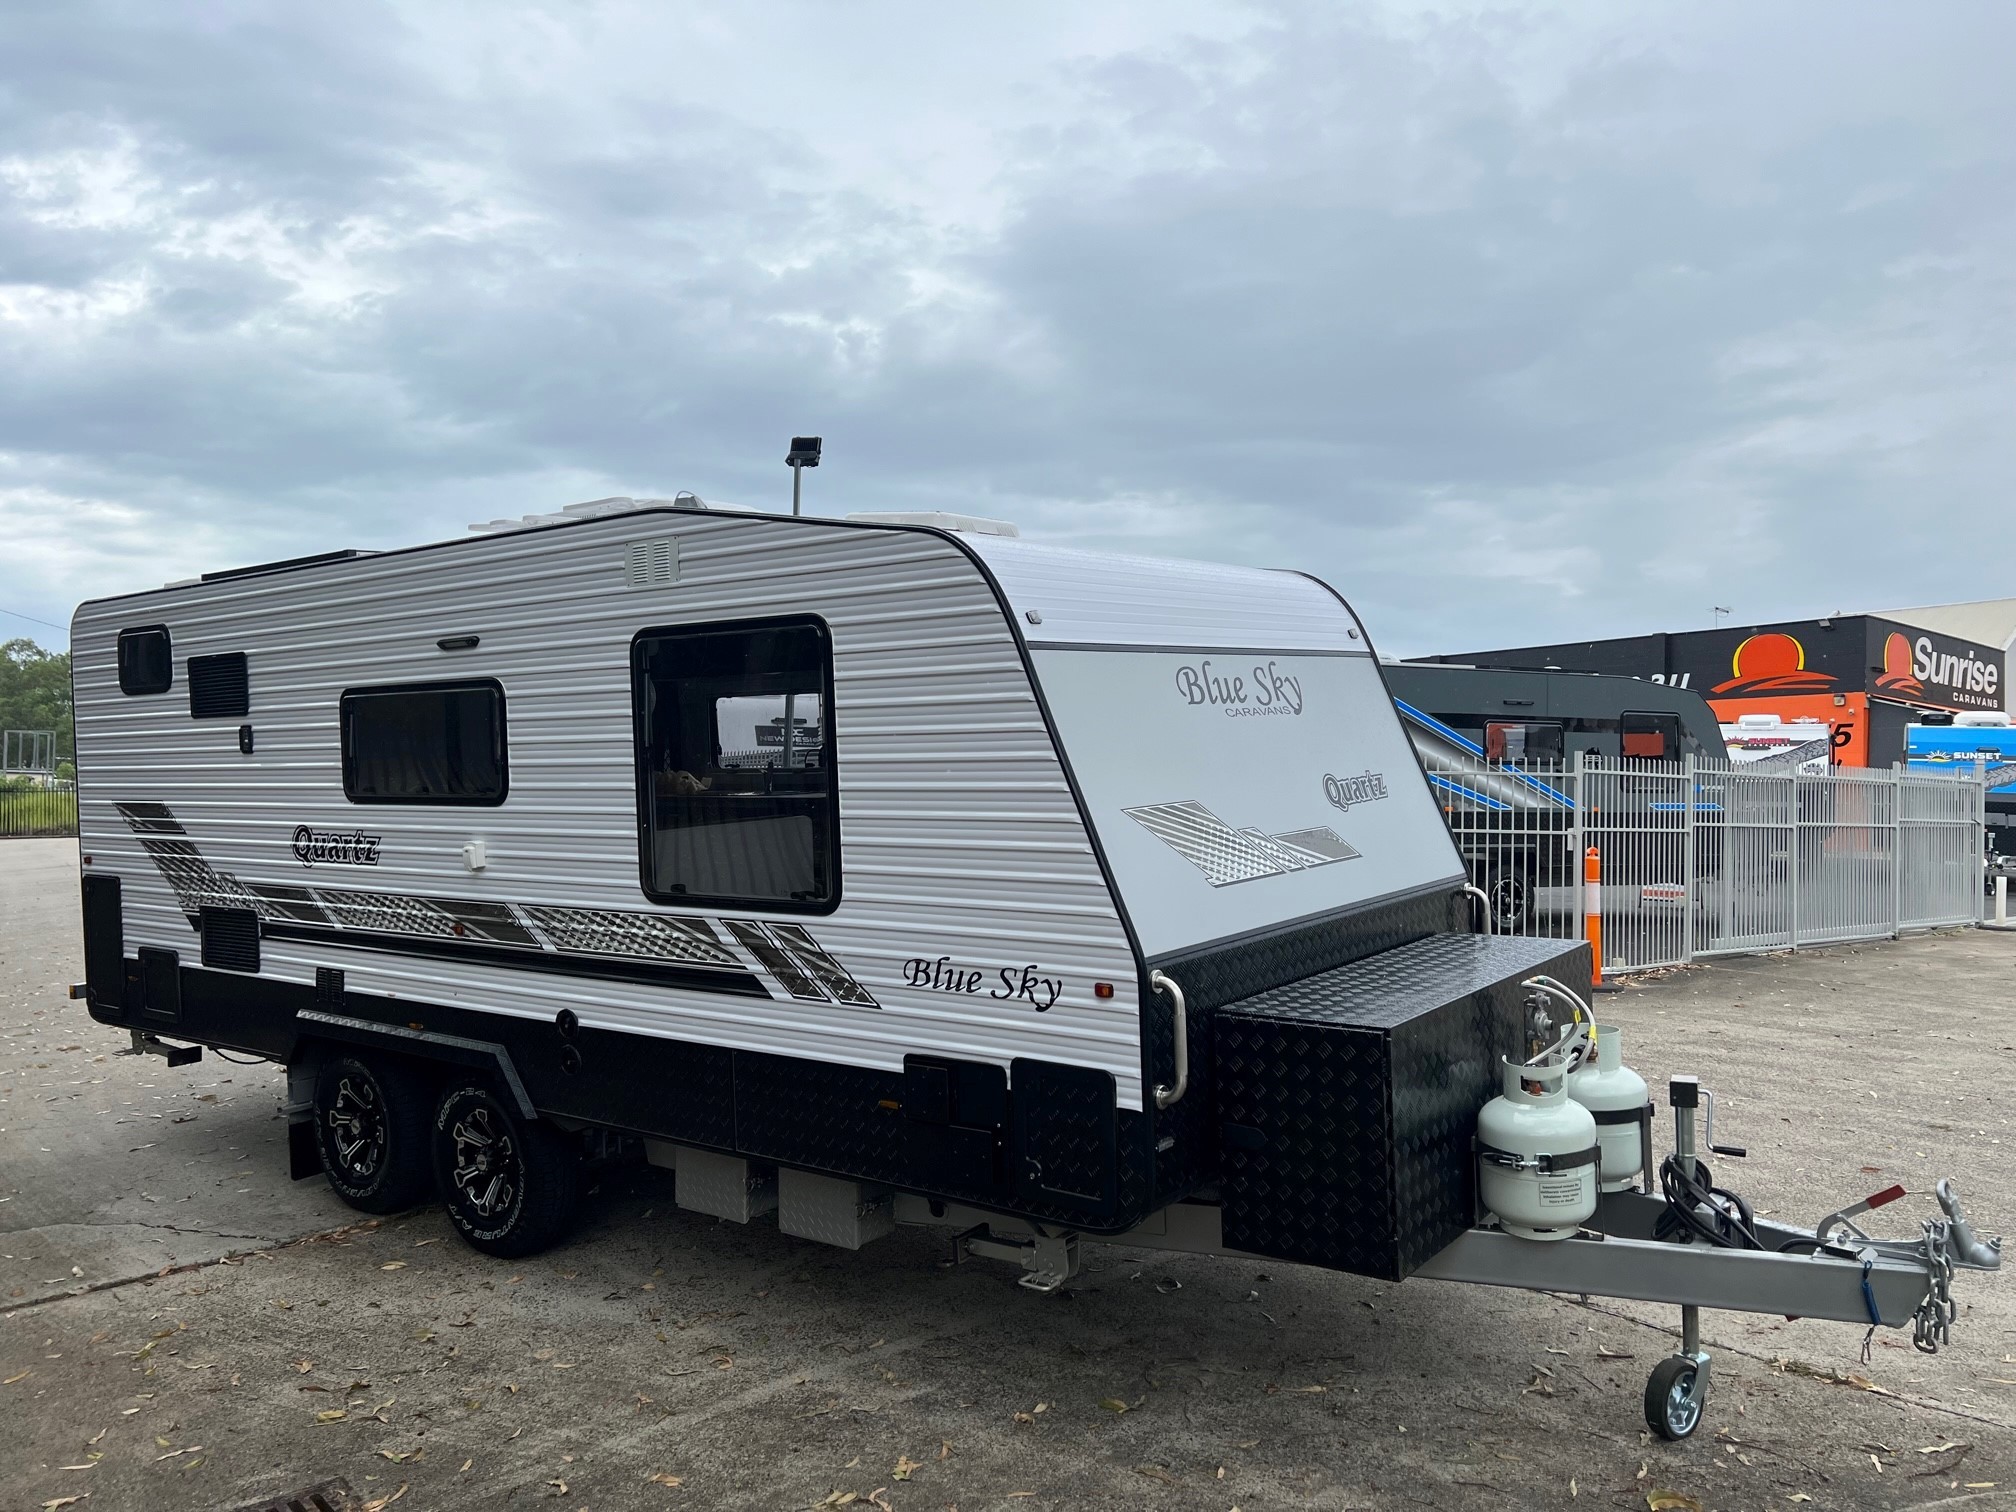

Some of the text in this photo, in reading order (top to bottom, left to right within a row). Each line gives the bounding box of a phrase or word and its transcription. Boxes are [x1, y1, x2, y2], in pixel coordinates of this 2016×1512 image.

[1913, 636, 1998, 695] Sunrise
[1175, 660, 1303, 716] Blue Sky
[1953, 692, 1998, 708] CARAVANS
[1225, 705, 1291, 718] CARAVANS
[1953, 751, 2002, 760] SUNSET
[1322, 770, 1389, 812] Quartz
[291, 824, 382, 868] Quartz
[903, 956, 1063, 1013] Blue Sky
